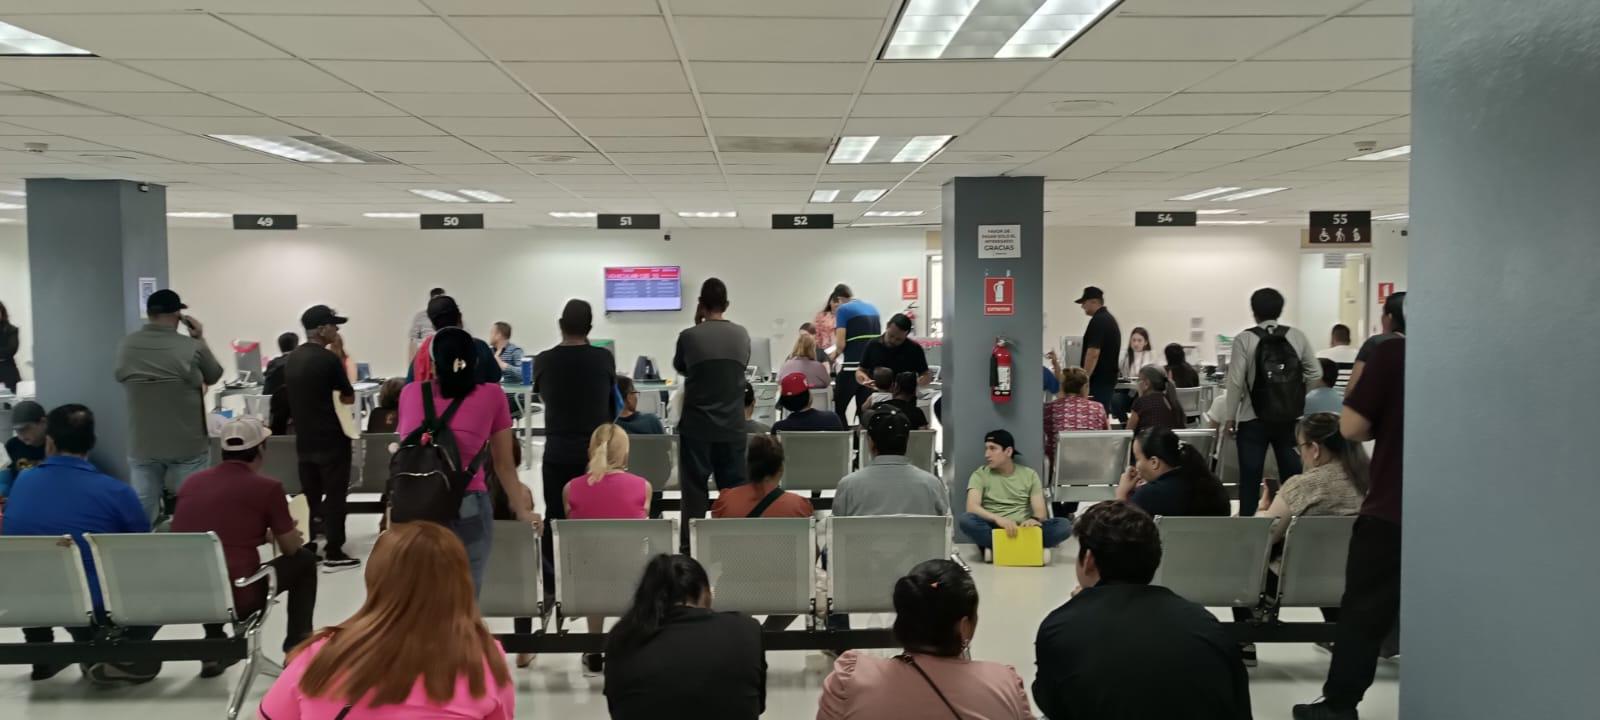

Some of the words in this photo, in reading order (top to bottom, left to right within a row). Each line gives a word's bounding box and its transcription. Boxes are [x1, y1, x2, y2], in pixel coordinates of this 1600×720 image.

[257, 217, 273, 227] 49
[443, 216, 459, 226] 50
[620, 216, 632, 226] 51
[793, 216, 808, 226] 52
[1157, 213, 1172, 223] 54
[1333, 213, 1348, 225] 55
